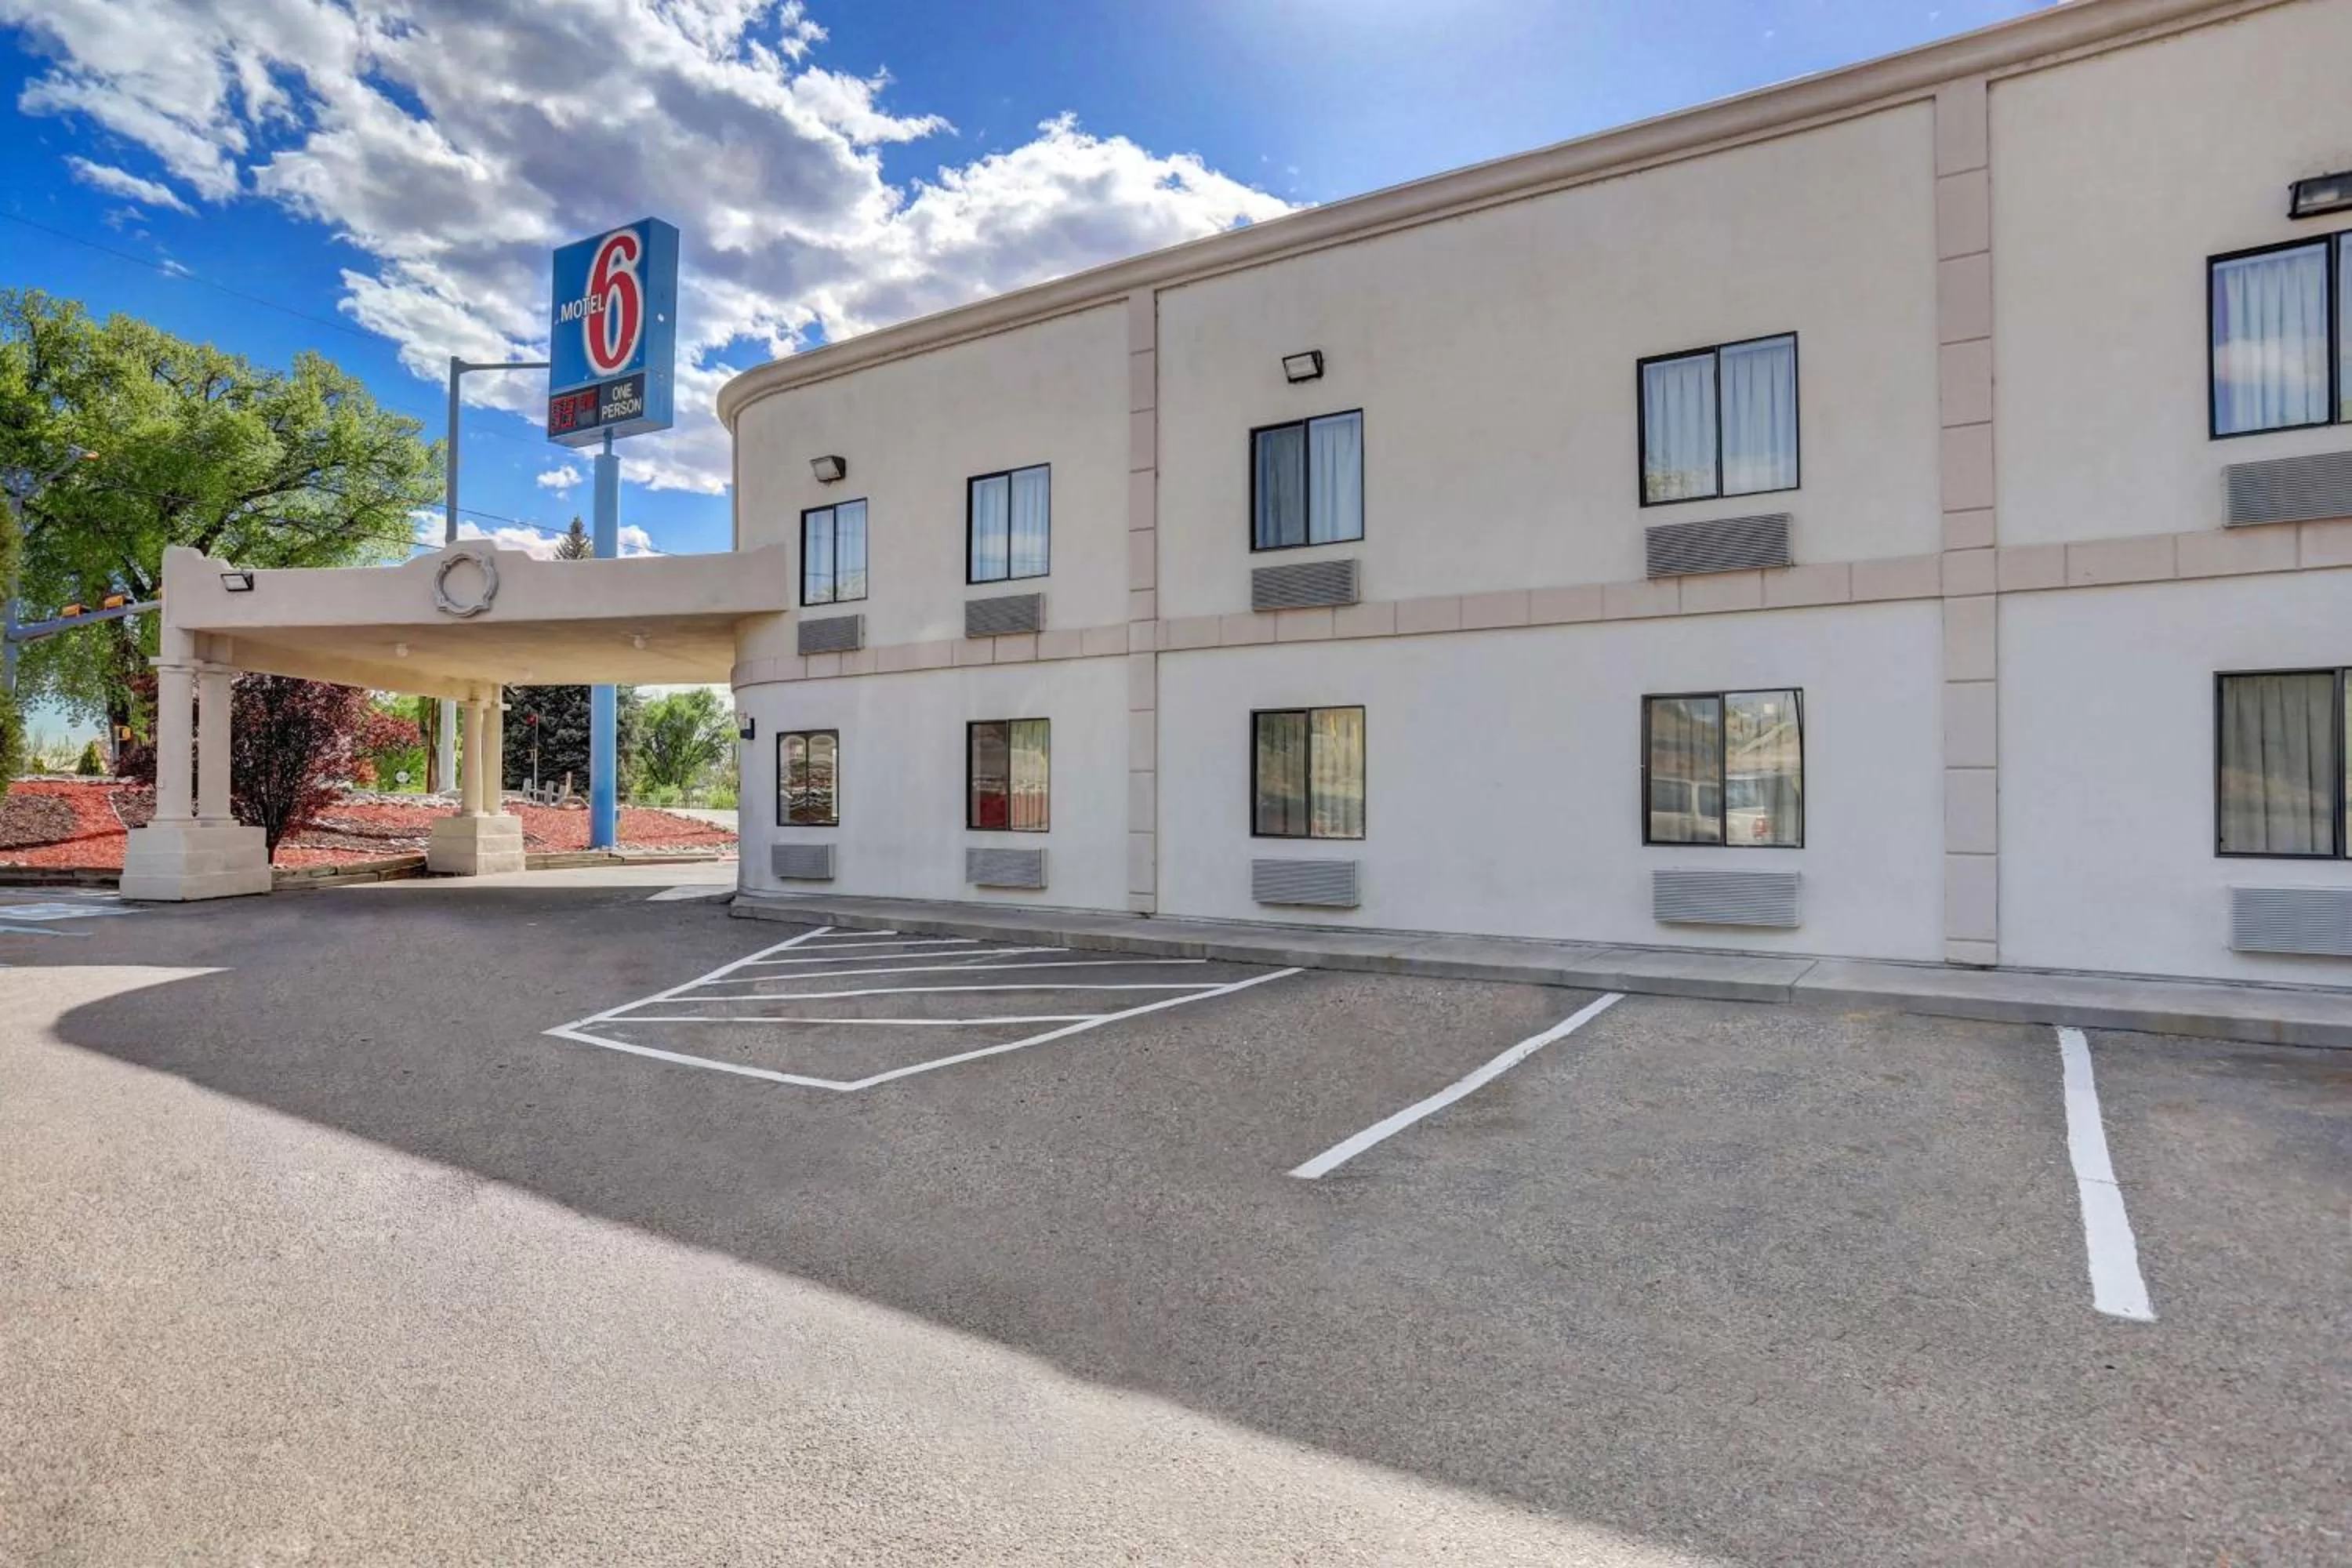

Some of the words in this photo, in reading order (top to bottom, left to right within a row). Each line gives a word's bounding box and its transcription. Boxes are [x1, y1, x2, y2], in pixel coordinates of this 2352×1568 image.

[561, 293, 604, 323] MOTEL
[586, 230, 641, 372] 6
[612, 383, 633, 401] ONE
[601, 397, 642, 419] PERSON
